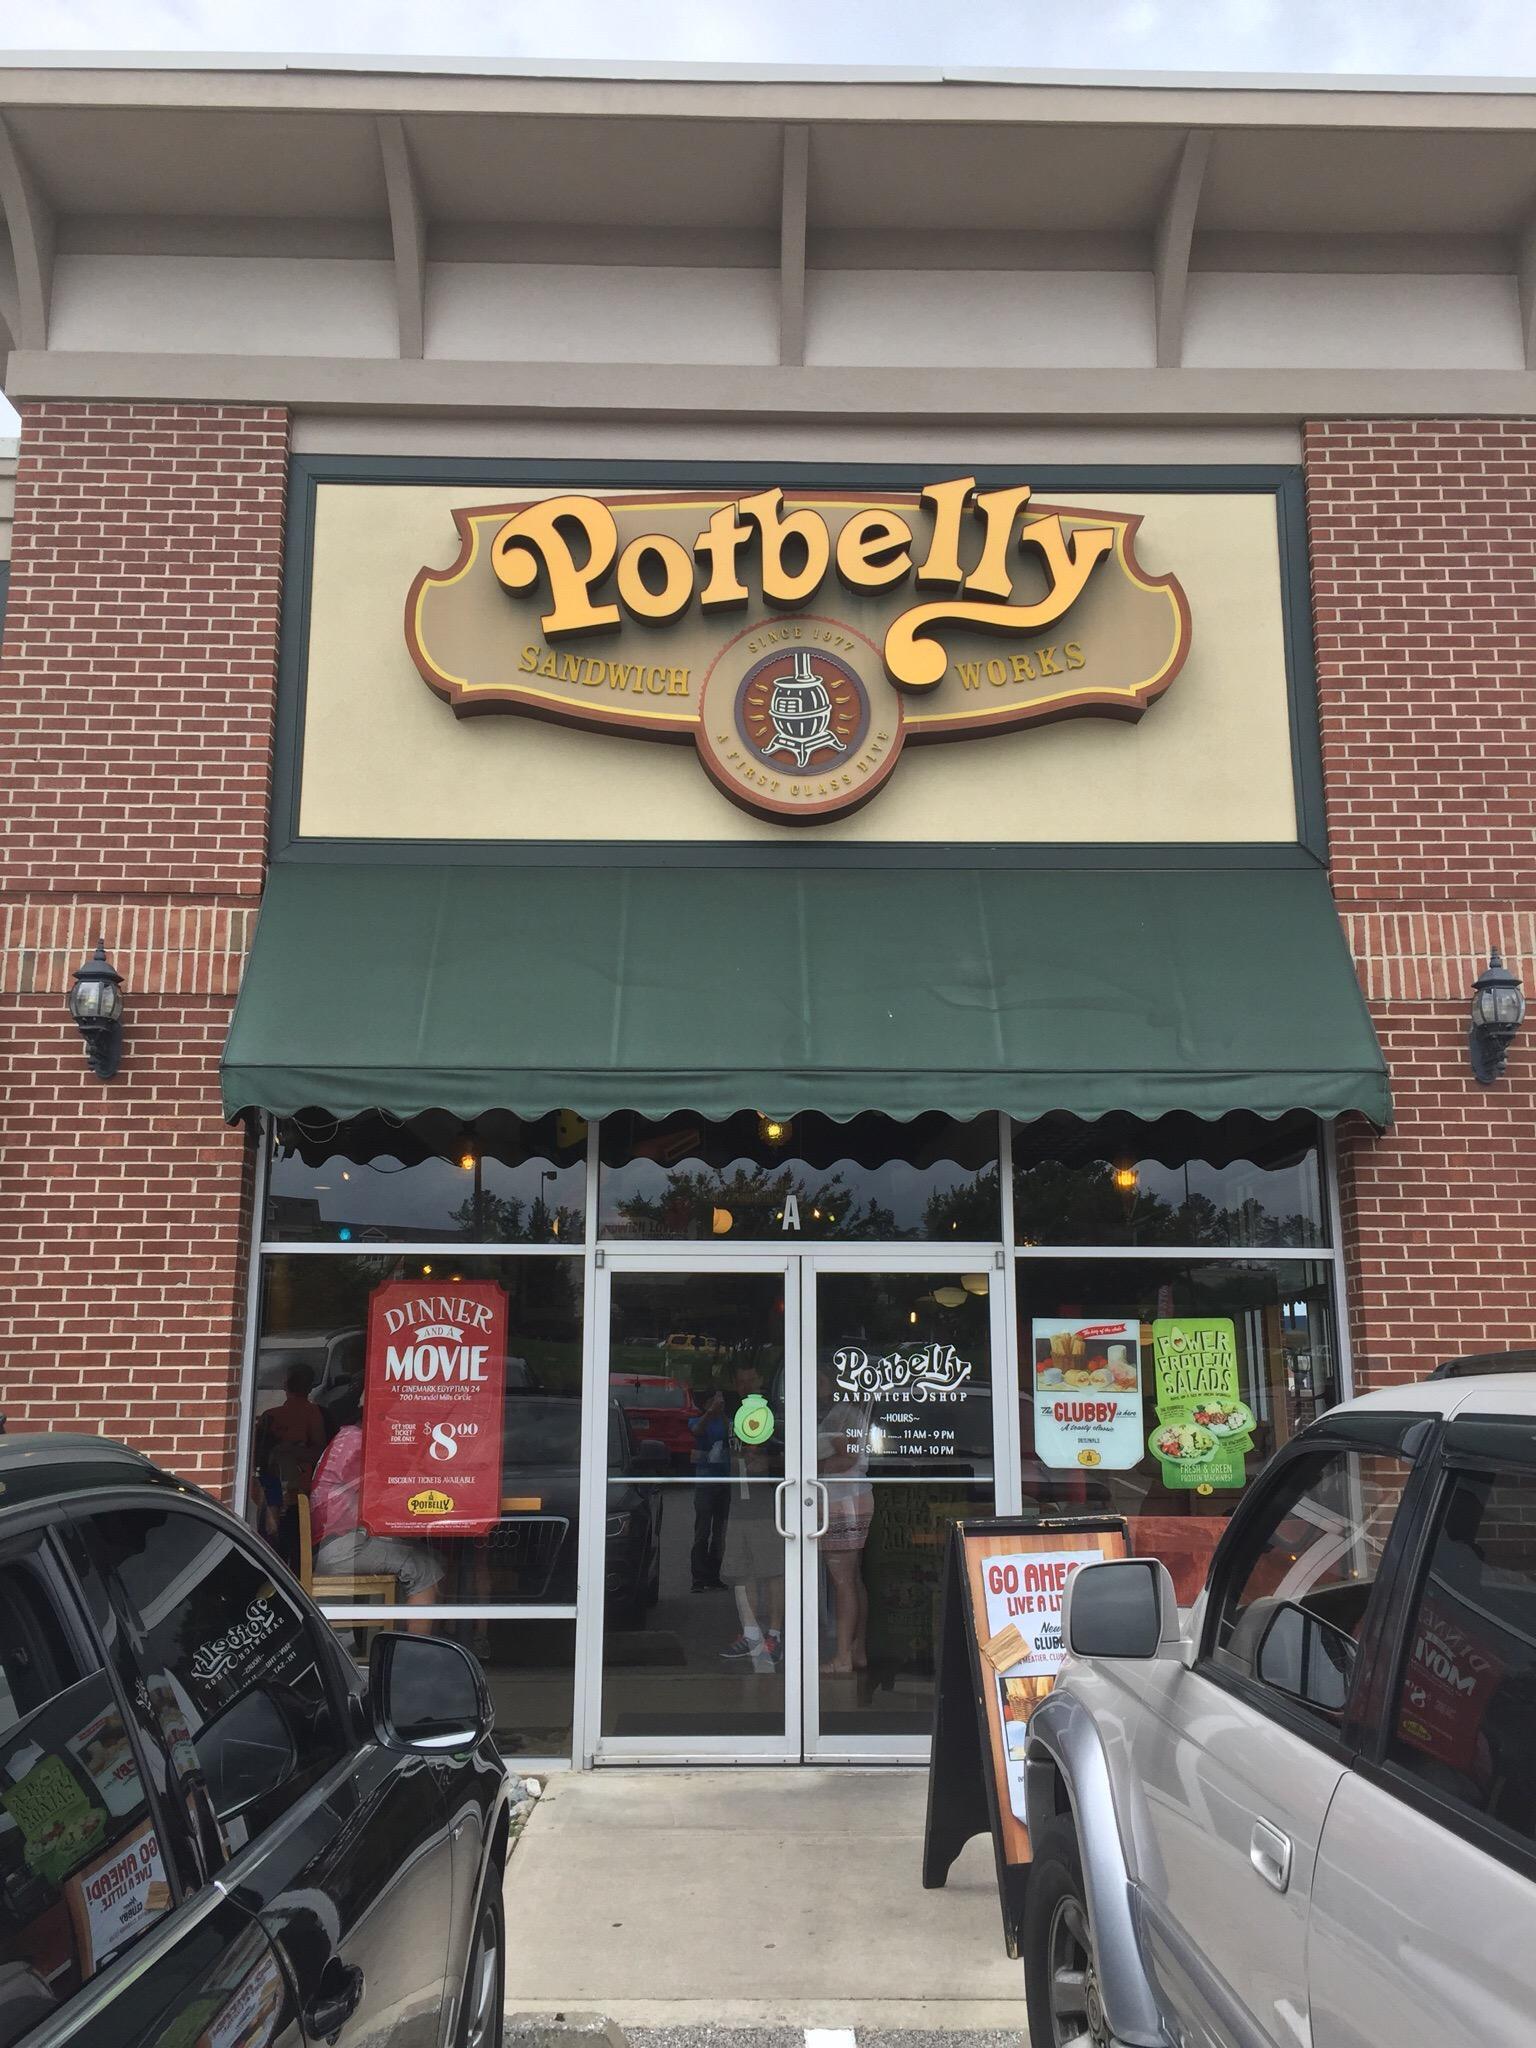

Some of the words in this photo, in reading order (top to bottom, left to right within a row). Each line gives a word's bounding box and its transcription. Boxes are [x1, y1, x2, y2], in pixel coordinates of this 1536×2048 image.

[491, 476, 1114, 688] Potbelly
[748, 627, 801, 653] SINCE
[813, 627, 855, 652] 1977
[518, 646, 690, 695] SANDWICH
[955, 641, 1086, 690] WORKS
[728, 752, 780, 792] FIRST
[790, 774, 853, 797] CLASS
[857, 732, 889, 774] DIVE
[782, 1195, 801, 1231] A
[383, 1296, 493, 1335] DINNER
[424, 1327, 443, 1337] AND
[447, 1328, 454, 1337] A
[1157, 1330, 1229, 1355] POWER
[385, 1345, 489, 1382] MOVIE
[833, 1343, 972, 1403] Potbelly
[1157, 1352, 1232, 1372] PROTEIN
[401, 1385, 436, 1393] CINEMARK
[1163, 1368, 1231, 1394] SALADS
[833, 1392, 909, 1402] SANDWICH
[930, 1392, 967, 1402] SHOP
[1054, 1402, 1117, 1423] CLUBBY
[846, 1428, 863, 1438] SUN
[904, 1430, 911, 1439] 11
[912, 1430, 927, 1439] AM
[933, 1430, 939, 1439] 9
[942, 1430, 954, 1439] PM
[846, 1444, 859, 1453] FRI
[900, 1445, 907, 1454] 11
[908, 1445, 922, 1454] AM
[929, 1445, 939, 1455] 10
[941, 1445, 954, 1455] PM
[1180, 1464, 1200, 1473] FRESH
[1210, 1464, 1232, 1473] GREEN
[411, 1499, 450, 1511] POTBELLY
[989, 1565, 1019, 1594] GO
[1007, 1596, 1034, 1617] LIVE
[1037, 1594, 1046, 1612] A
